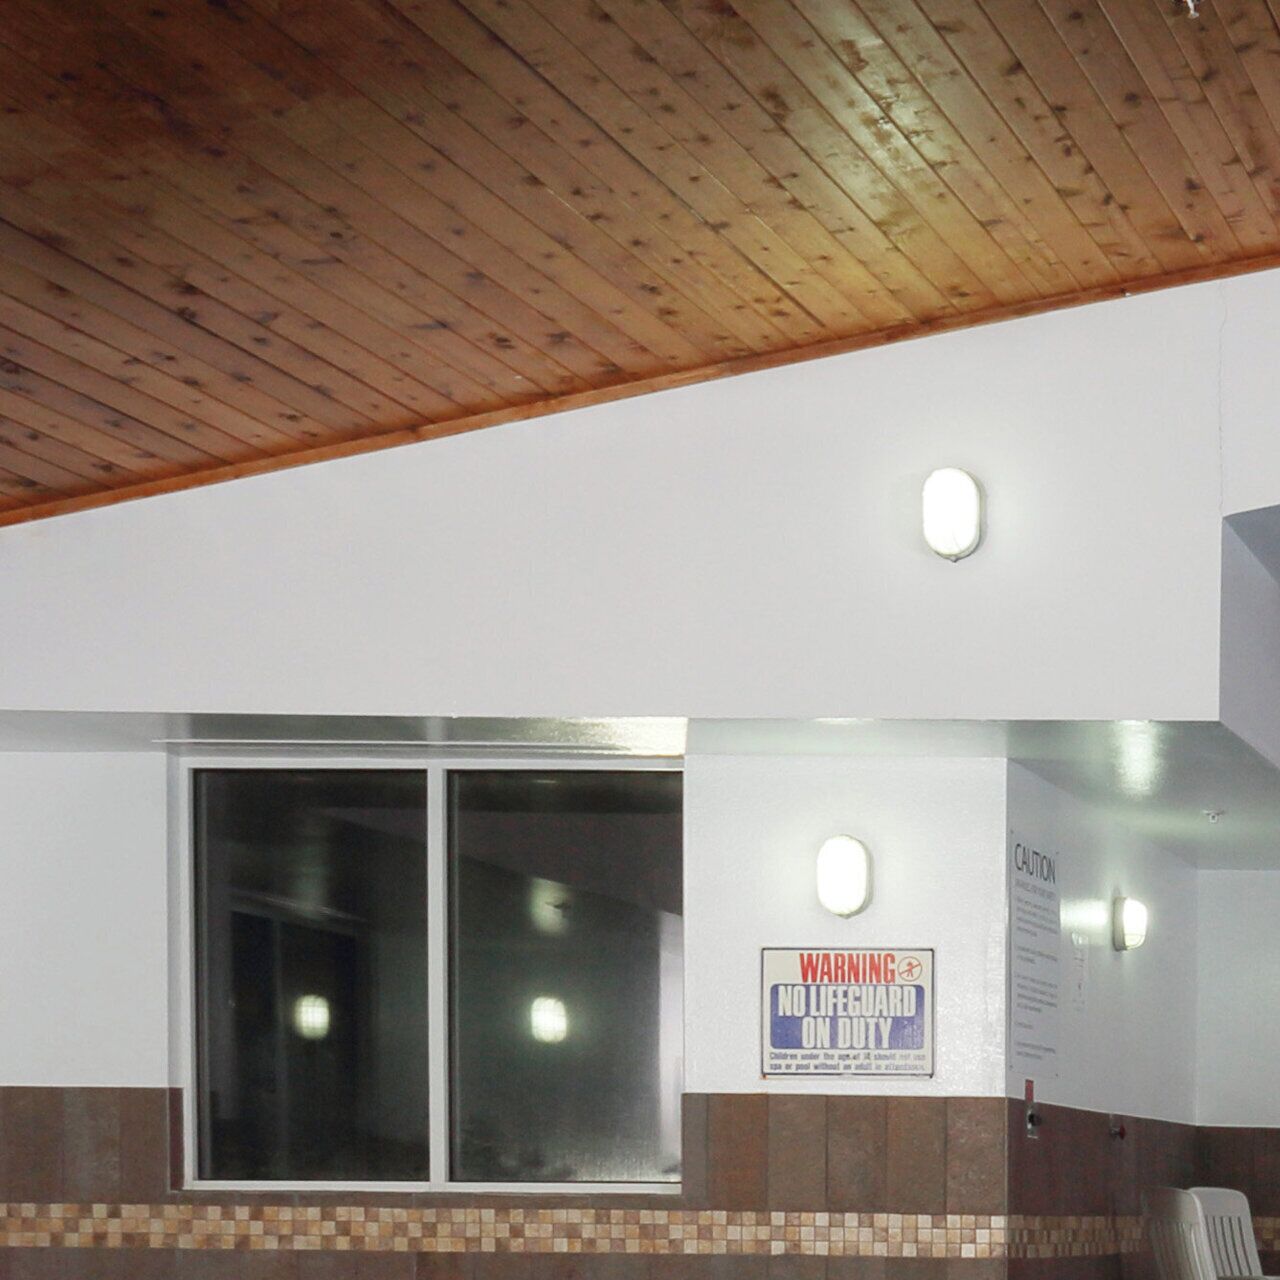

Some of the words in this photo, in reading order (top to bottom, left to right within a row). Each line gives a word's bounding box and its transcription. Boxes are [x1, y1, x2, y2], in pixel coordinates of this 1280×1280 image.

[1015, 843, 1056, 884] CAUTION
[799, 952, 895, 984] WARNING
[778, 985, 806, 1017] NO
[808, 985, 916, 1017] LIFEGUARD
[801, 1017, 830, 1049] ON
[837, 1017, 893, 1049] DUTY
